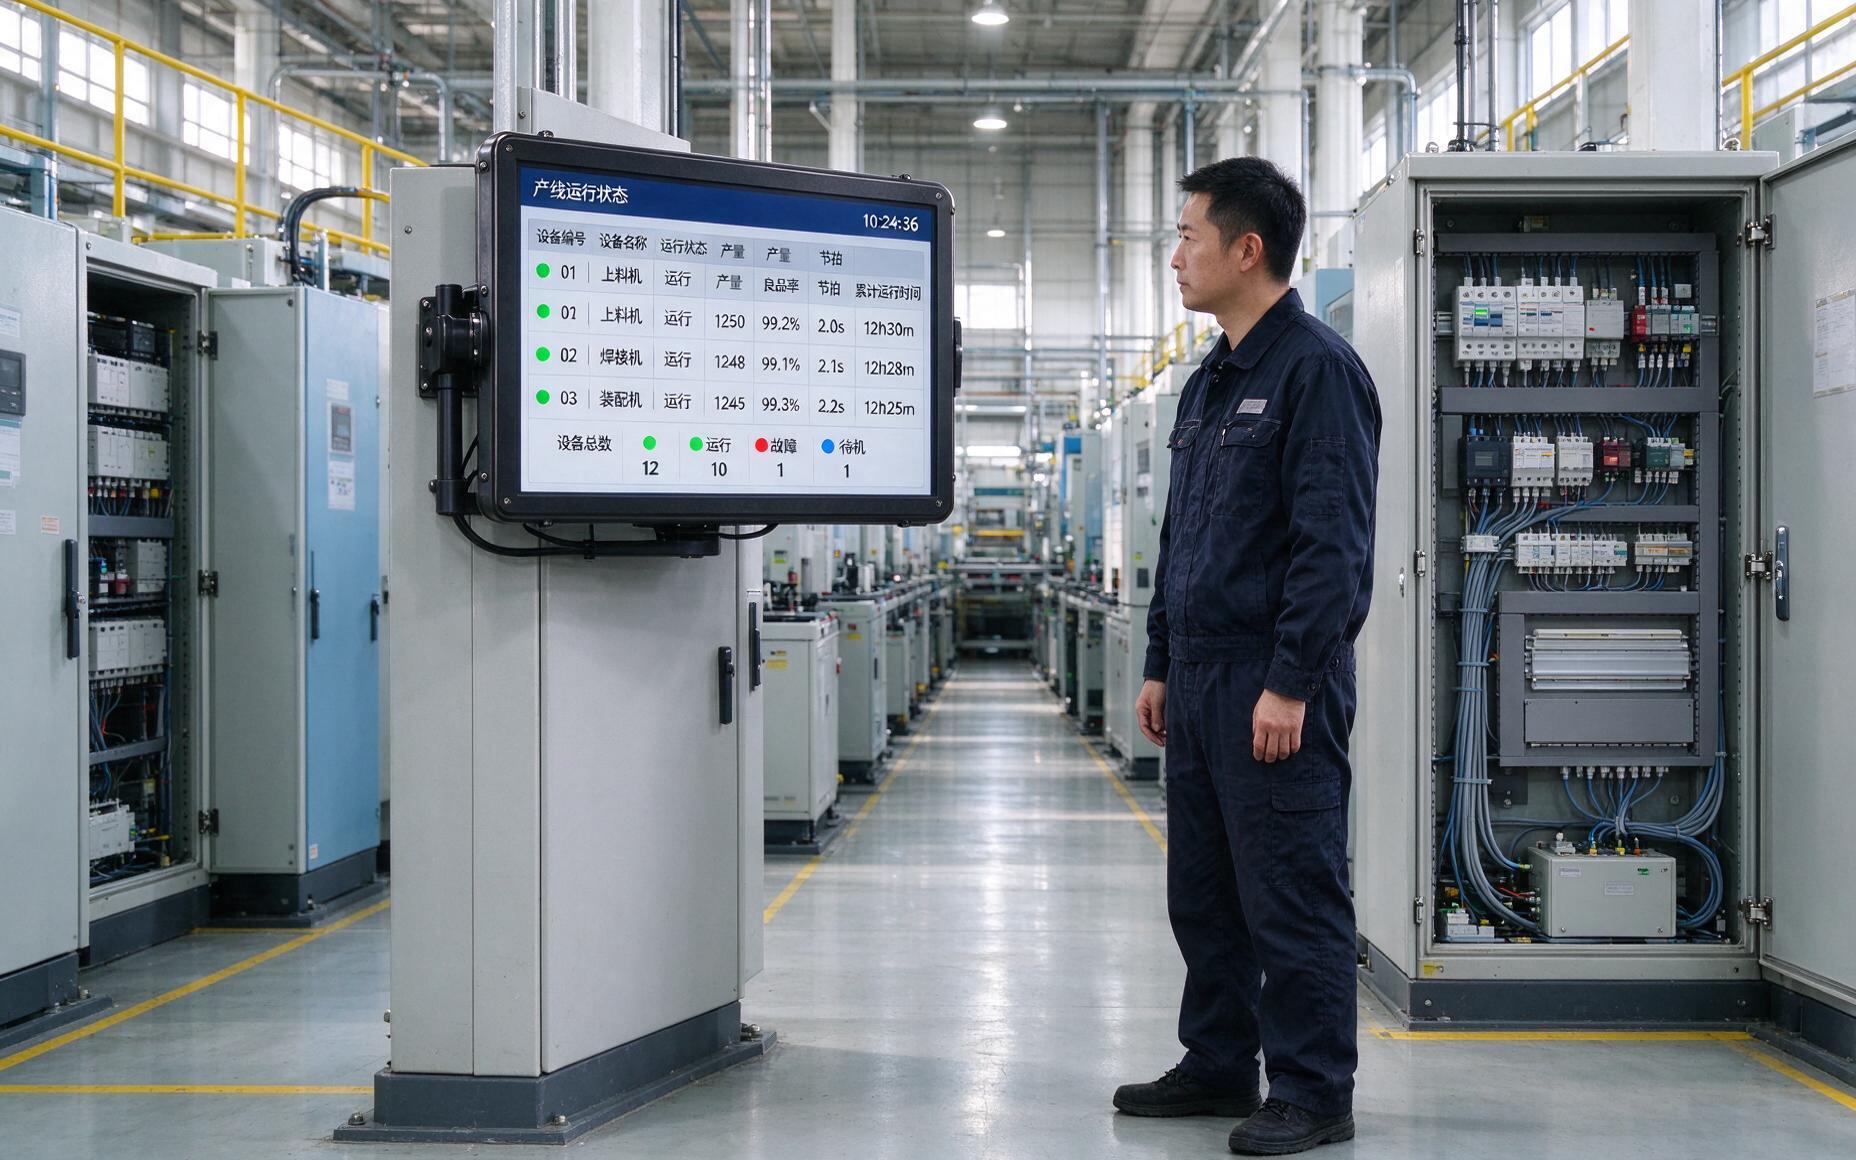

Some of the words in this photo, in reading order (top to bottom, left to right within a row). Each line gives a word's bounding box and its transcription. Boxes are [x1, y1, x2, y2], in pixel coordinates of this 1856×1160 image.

[533, 178, 628, 204] 产线运行状态
[864, 214, 918, 232] 10:24:36
[537, 229, 586, 246] 设备编号
[600, 233, 647, 250] 设备名称
[661, 239, 707, 255] 运行状态
[721, 243, 744, 259] 产量
[767, 247, 791, 262] 产量
[561, 265, 575, 279] 01
[601, 266, 642, 284] 上料机
[665, 270, 691, 287] 运行
[716, 274, 742, 290] 产量
[764, 277, 799, 293] 良品率
[856, 283, 921, 301] 累计运行时间
[601, 306, 642, 324] 上料机
[664, 309, 692, 326] 运行
[715, 314, 745, 328] 1250
[762, 316, 800, 331] 99.2%
[818, 319, 844, 333] 2.0s
[864, 321, 913, 337] 12h30m
[561, 348, 576, 362] 02
[600, 348, 642, 366] 焊接机
[664, 351, 691, 368] 运行
[715, 355, 745, 369] 1248
[762, 357, 800, 371] 99.1%
[818, 359, 844, 373] 2.1s
[865, 361, 914, 376] 12h28m
[561, 391, 577, 405] 03
[600, 389, 642, 408] 装配机
[664, 393, 691, 409] 运行
[715, 396, 745, 410] 1245
[762, 397, 799, 411] 99.3%
[818, 399, 845, 413] 2.2s
[865, 401, 914, 416] 12h25m
[706, 437, 731, 453] 运行
[771, 438, 797, 454] 故障
[643, 461, 659, 475] 12
[712, 462, 727, 476] 10
[777, 463, 783, 477] 1
[844, 464, 849, 478] 1
